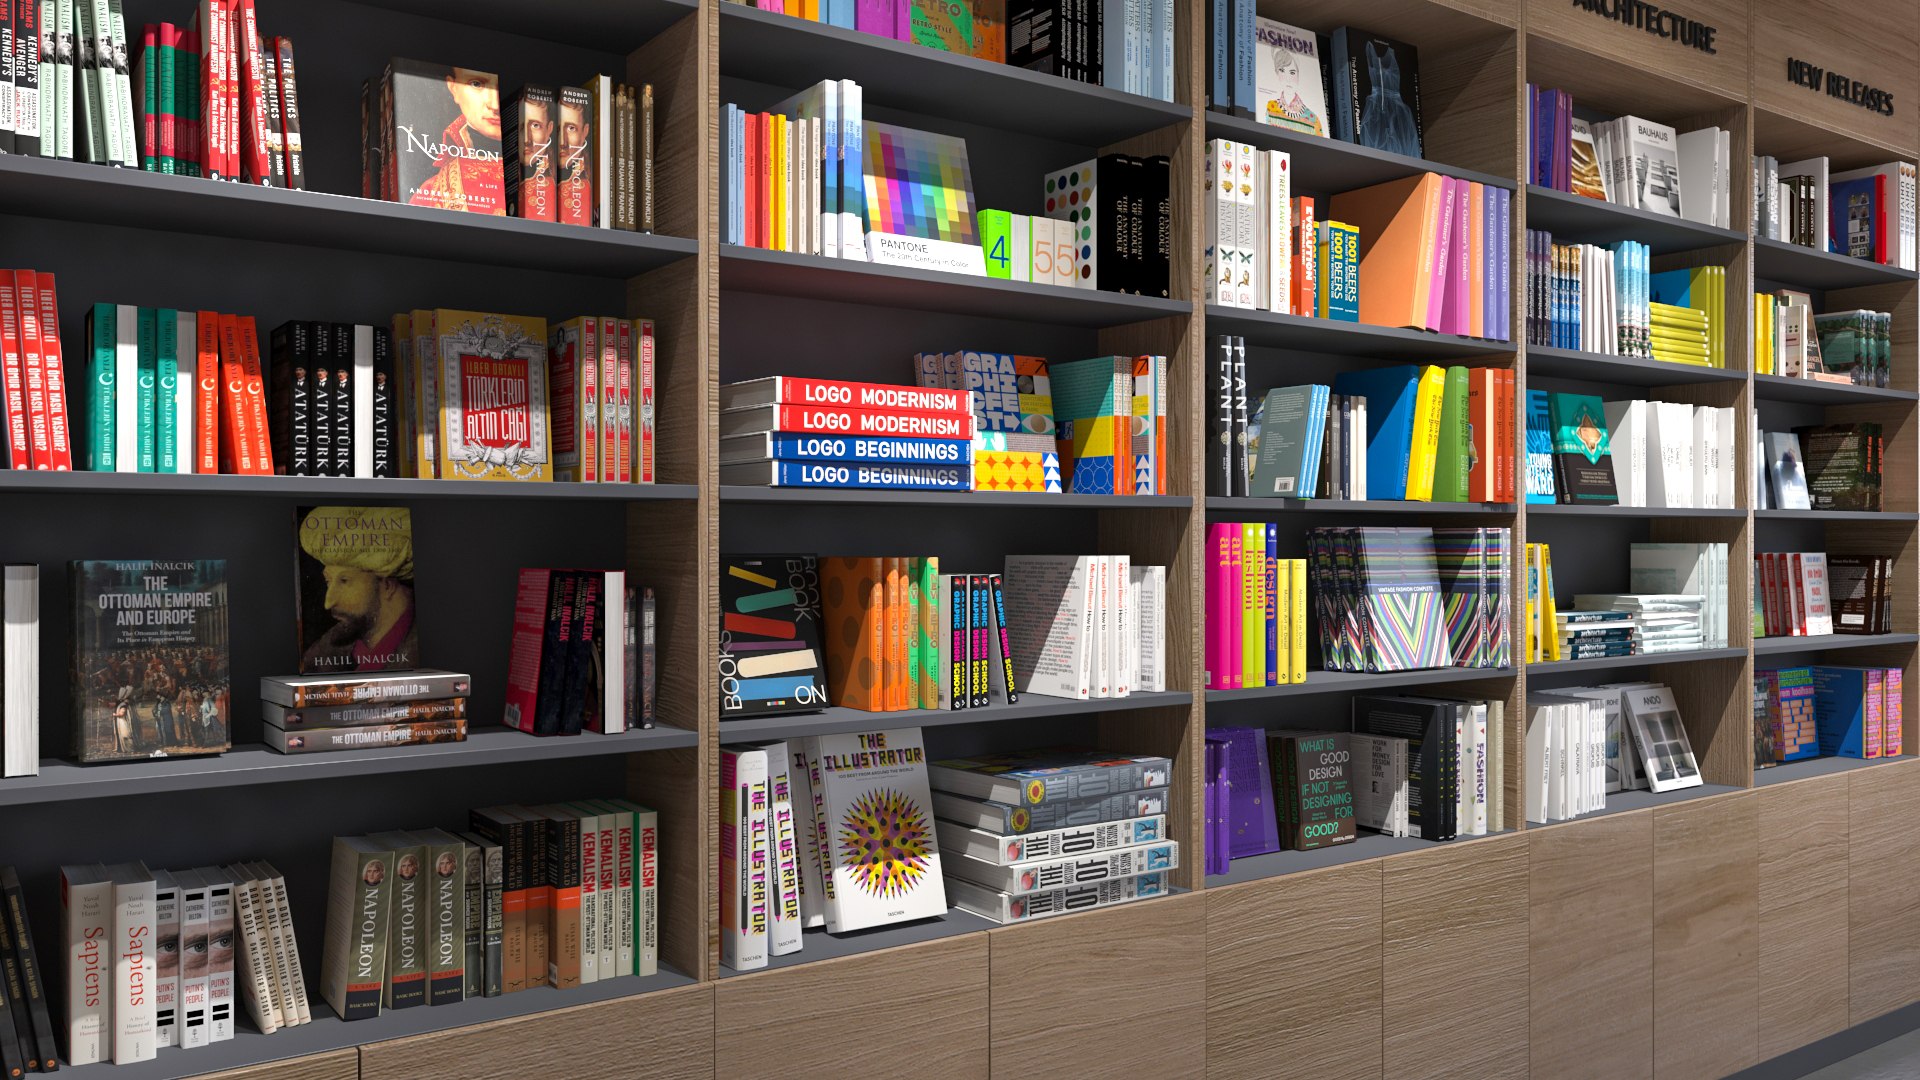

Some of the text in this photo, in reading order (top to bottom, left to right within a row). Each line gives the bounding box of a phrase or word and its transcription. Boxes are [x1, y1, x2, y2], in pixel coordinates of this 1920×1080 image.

[2, 27, 12, 76] KENNEDY'S
[1256, 28, 1314, 56] FASHION
[16, 38, 26, 77] AVENGER
[27, 35, 38, 83] KENNEDY'S
[268, 78, 280, 118] POLITICS
[284, 78, 296, 119] POLITICS
[527, 94, 552, 102] ROBERTS
[528, 87, 552, 96] ANDREW
[563, 90, 588, 98] ANDREW
[1787, 57, 1895, 117] NEW RELEASES
[563, 97, 588, 105] ROBERTS
[397, 125, 499, 163] NAPOLEON
[1638, 126, 1668, 142] BAUHAUS
[530, 138, 552, 216] NAPOLEON
[410, 188, 450, 198] ANDREW
[454, 193, 496, 204] ROBERTS
[880, 238, 928, 254] PANTONE
[989, 236, 1009, 268] 4
[1035, 240, 1052, 273] 5
[1057, 244, 1074, 277] 5
[1334, 232, 1343, 299] 1001 BEERS
[1348, 235, 1356, 302] 1001 BEERS
[1438, 248, 1446, 276] Garden
[493, 362, 525, 376] ORTAYLI
[963, 352, 1016, 374] GRA
[966, 372, 1017, 393] PHI
[1221, 345, 1232, 426] PLANT
[1234, 346, 1248, 426] PLANT
[10, 391, 22, 412] NASIL
[30, 391, 43, 412] NASIL
[50, 393, 62, 414] NASIL
[805, 384, 957, 410] LOGO MODERNISM
[295, 388, 309, 468] ATATÜRK
[316, 389, 330, 469] ATATÜRK
[337, 391, 351, 469] ATATÜRK
[376, 393, 389, 471] ATATÜRK
[465, 412, 498, 440] ALTIN
[803, 412, 960, 435] LOGO MODERNISM
[797, 439, 959, 460] LOGO BEGINNINGS
[1528, 452, 1552, 466] YOUNG
[802, 466, 959, 485] LOGO BEGINNINGS
[1526, 478, 1554, 495] WARD
[305, 517, 403, 530] OTTOMAN
[322, 533, 390, 546] EMPIRE
[1220, 537, 1230, 566] art
[1232, 537, 1242, 566] art
[143, 576, 168, 591] THE
[786, 559, 812, 622] BOOK
[1246, 550, 1254, 610] fashion
[1257, 550, 1265, 610] fashion
[1266, 556, 1277, 620] design
[99, 592, 212, 609] OTTOMAN EMPIRE
[116, 609, 196, 626] AND EUROPE
[1575, 614, 1602, 622] architecture
[995, 591, 1015, 692] GRAPHIC DESIGN SCHOOL
[719, 630, 742, 711] BOOKS
[795, 684, 827, 704] ON
[1643, 696, 1661, 705] ANDO
[342, 706, 409, 721] OTTOMAN EMPIRE
[344, 729, 411, 744] OTTOMAN EMPIRE
[858, 732, 887, 749] THE
[1300, 739, 1334, 752] WHAT IS
[824, 747, 924, 772] ILLUSTRATOR
[1320, 751, 1349, 765] GOOD
[1309, 766, 1342, 780] DESIGN
[1302, 781, 1329, 796] IF NOT
[1303, 793, 1352, 810] DESIGNING
[1335, 806, 1353, 818] FOR
[1304, 822, 1339, 838] GOOD?
[775, 772, 798, 920] THE ILLUSTRATOR
[814, 793, 835, 900] ILLUSTRATOR
[1050, 833, 1060, 855] HISTORY
[1061, 831, 1095, 853] OF
[583, 832, 595, 893] KEMALISM
[601, 830, 612, 890] KEMALISM
[619, 828, 631, 887] KEMALISM
[642, 828, 654, 887] KEMALISM
[751, 780, 766, 935] THE ILLUSTRATOR
[1064, 862, 1074, 884] HISTORY
[1076, 859, 1108, 882] OF
[1065, 887, 1098, 910] OF
[243, 913, 256, 936] DOLE
[253, 909, 265, 931] DOLE
[267, 909, 278, 931] DOLE
[402, 882, 415, 969] NAPOLEON
[440, 880, 453, 966] NAPOLEON
[358, 888, 378, 978] NAPOLEON
[78, 927, 104, 1007] Sapiens
[122, 926, 148, 1006] Sapiens
[273, 936, 293, 1010] ONE SOLDIER'S STORY
[156, 983, 174, 992] PUTIN'S
[185, 983, 204, 993] PUTIN'S
[211, 978, 229, 987] PUTIN'S
[250, 942, 270, 1016] ONE SOLDIER'S STORY
[262, 952, 276, 987] SOLDIER'S
[270, 989, 280, 1010] STORY
[156, 993, 174, 1004] PEOPLE
[185, 994, 203, 1004] PEOPLE
[211, 989, 229, 998] PEOPLE
